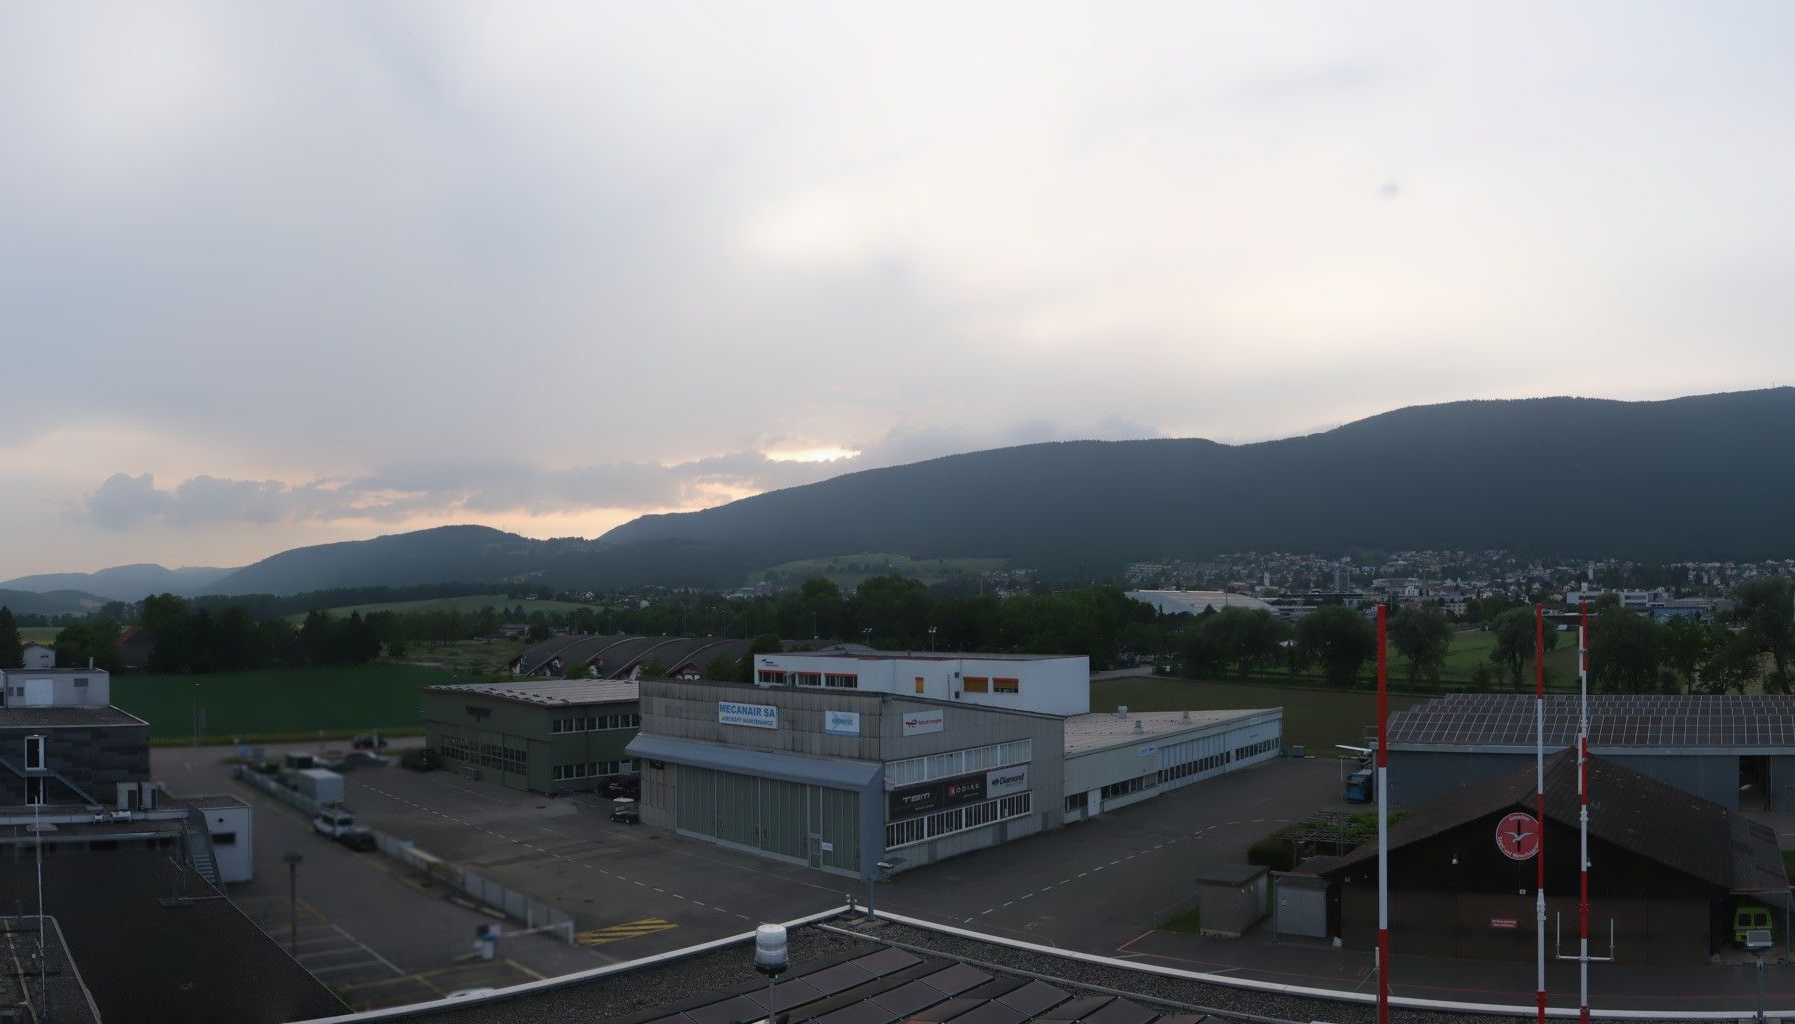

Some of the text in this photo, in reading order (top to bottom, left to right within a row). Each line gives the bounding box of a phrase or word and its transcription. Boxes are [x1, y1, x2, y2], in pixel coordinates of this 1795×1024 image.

[719, 703, 776, 718] MECANAIR SA
[950, 783, 981, 795] KODIAK
